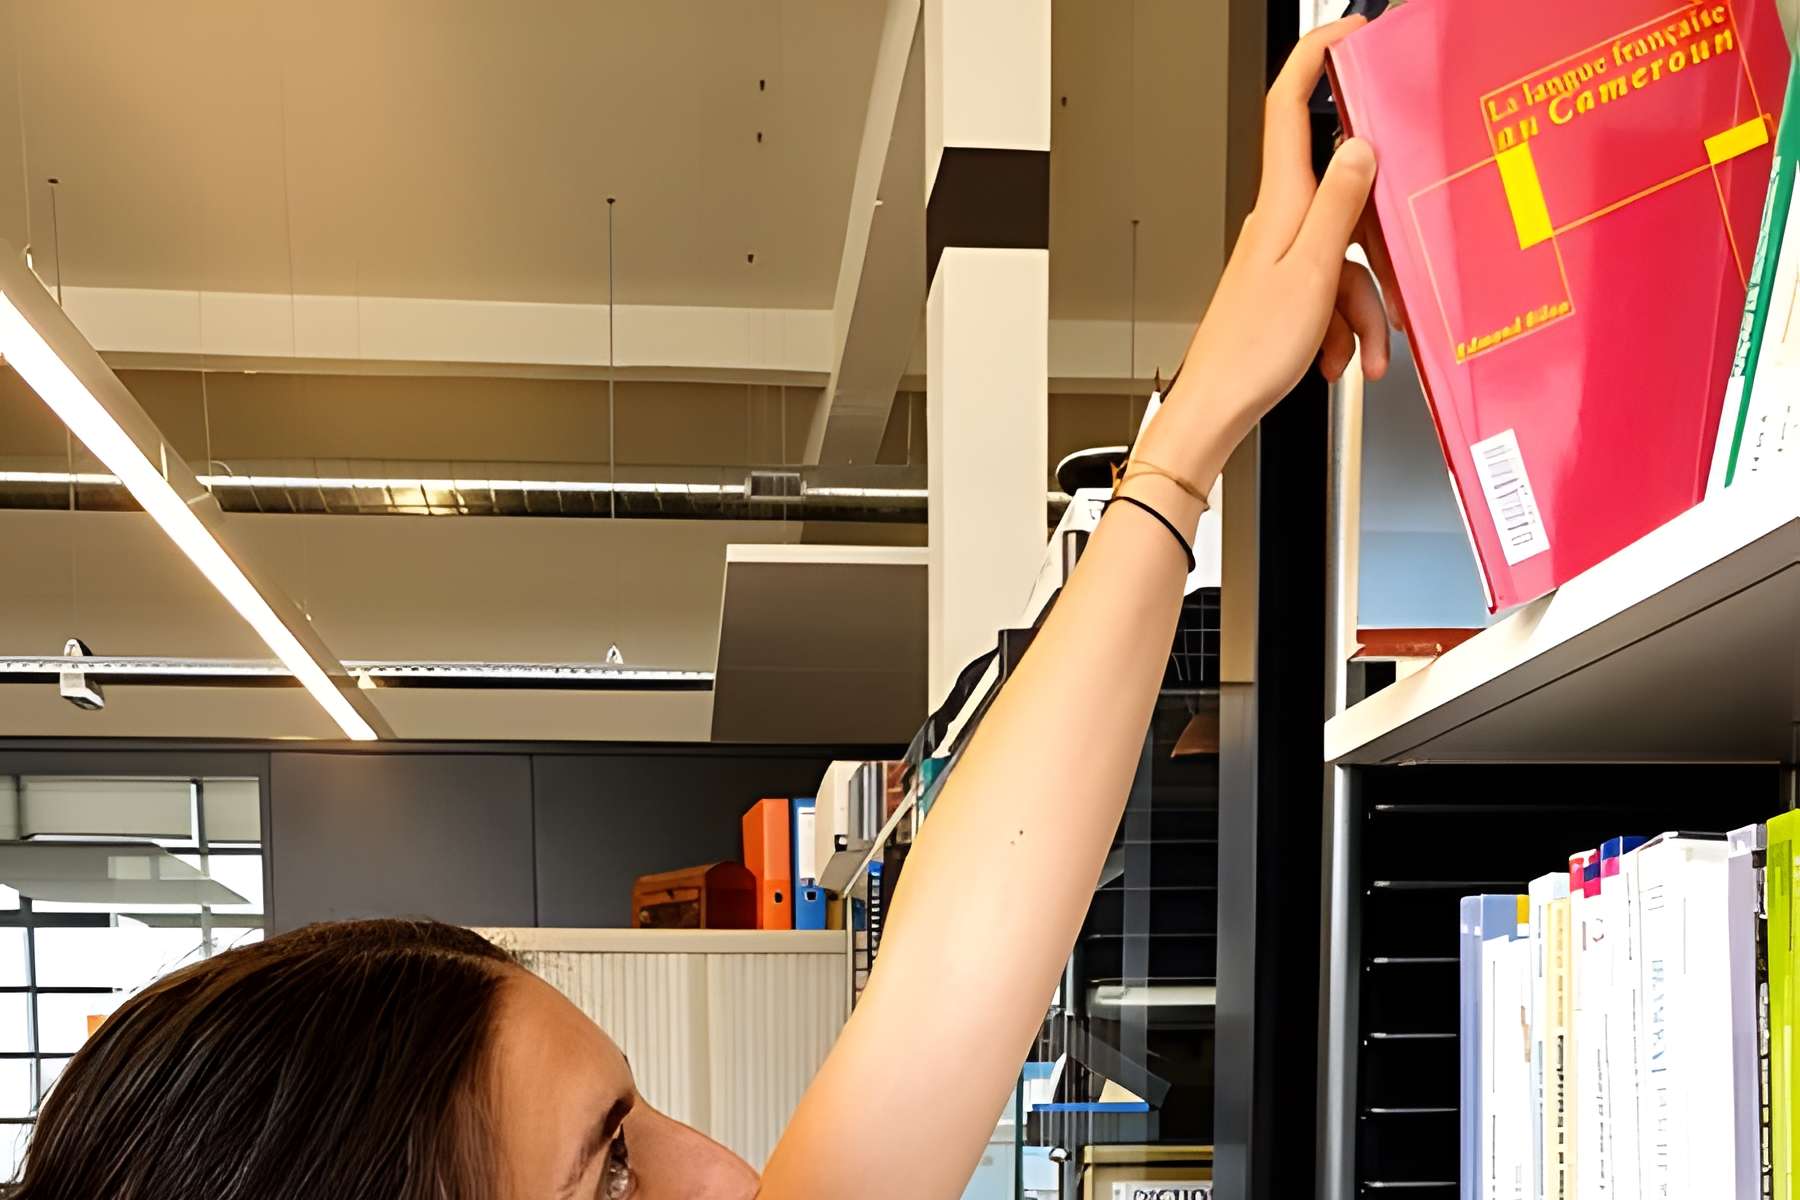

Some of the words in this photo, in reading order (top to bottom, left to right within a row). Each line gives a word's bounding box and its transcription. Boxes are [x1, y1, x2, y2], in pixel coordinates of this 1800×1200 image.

[1487, 97, 1519, 122] La
[1611, 5, 1726, 67] française
[1548, 28, 1734, 125] Cameroun
